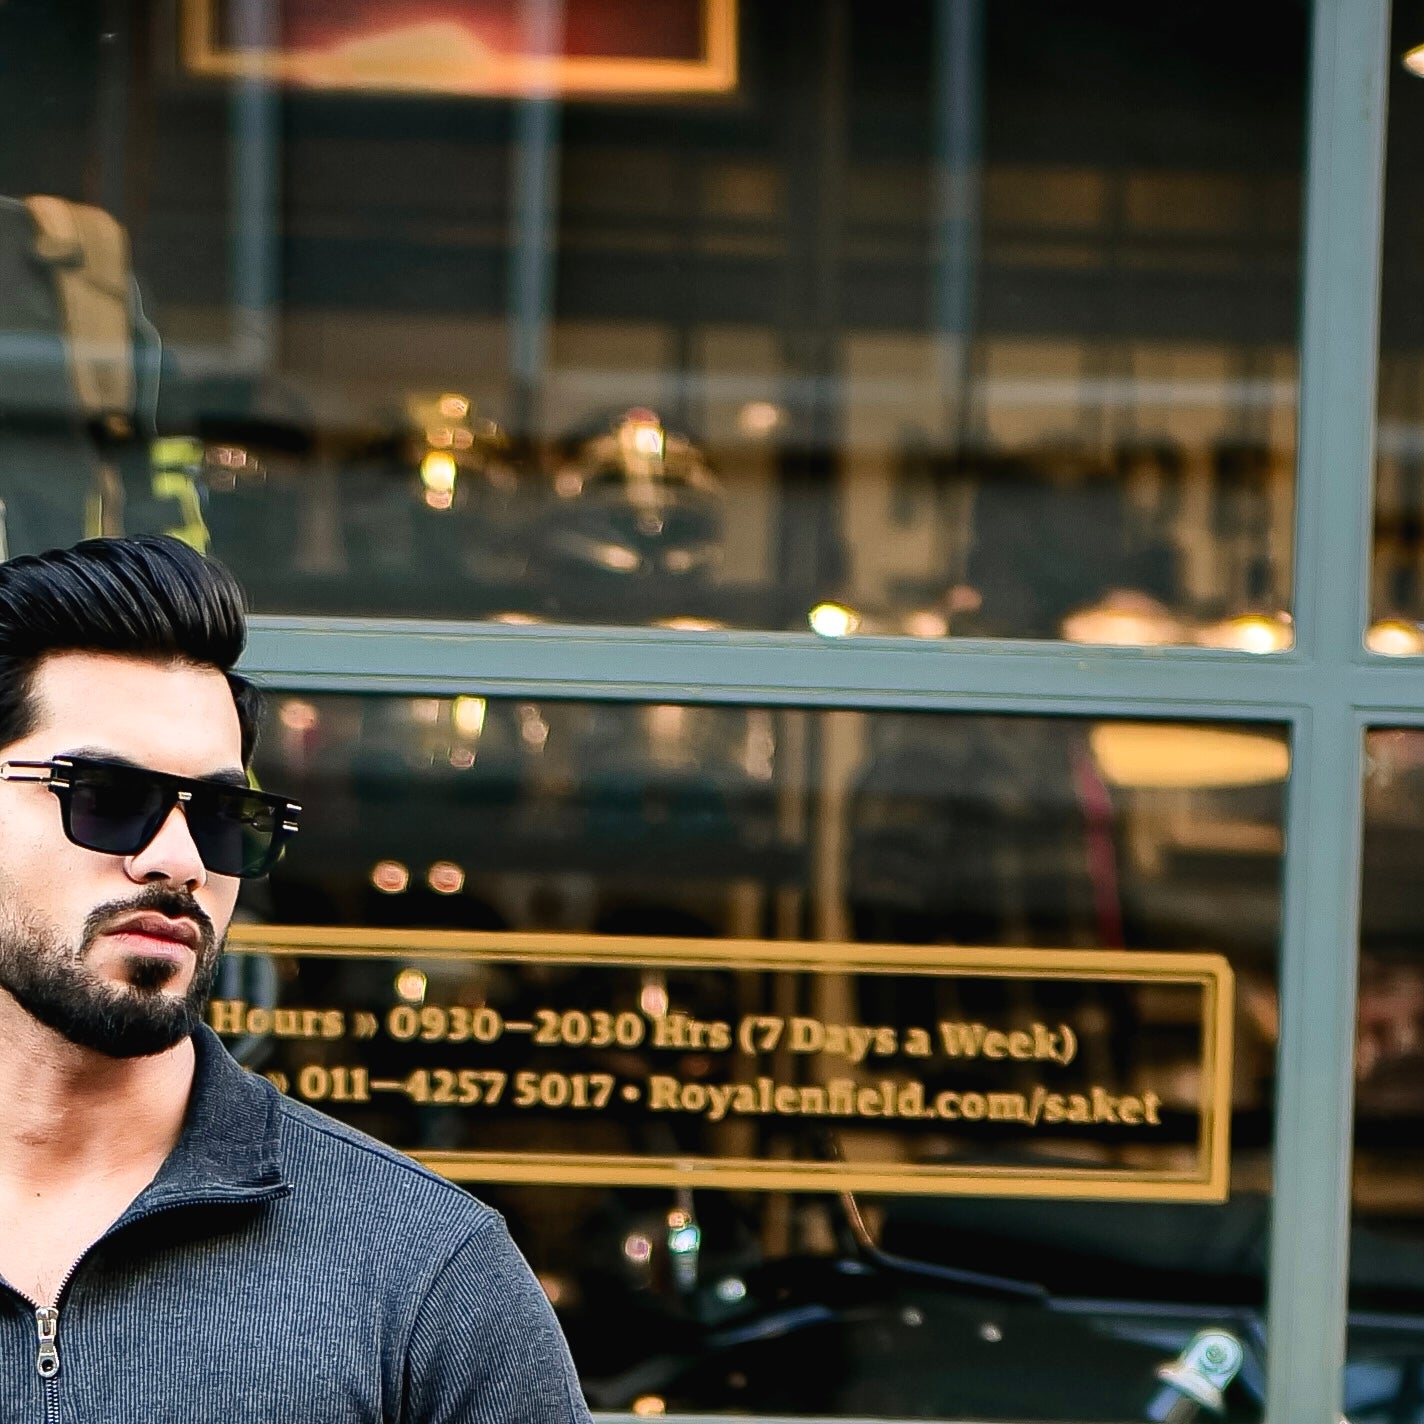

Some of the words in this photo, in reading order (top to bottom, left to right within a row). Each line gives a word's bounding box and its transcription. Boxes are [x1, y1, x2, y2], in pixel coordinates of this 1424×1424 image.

[212, 999, 345, 1038] Hours
[652, 1012, 731, 1049] Hrs
[739, 1014, 784, 1056] (7
[788, 1016, 897, 1064] Days
[904, 1027, 931, 1056] a
[938, 1021, 1078, 1066] Week)
[513, 1072, 616, 1109] 5017
[647, 1073, 1162, 1127] Royalenfield.com/saket
